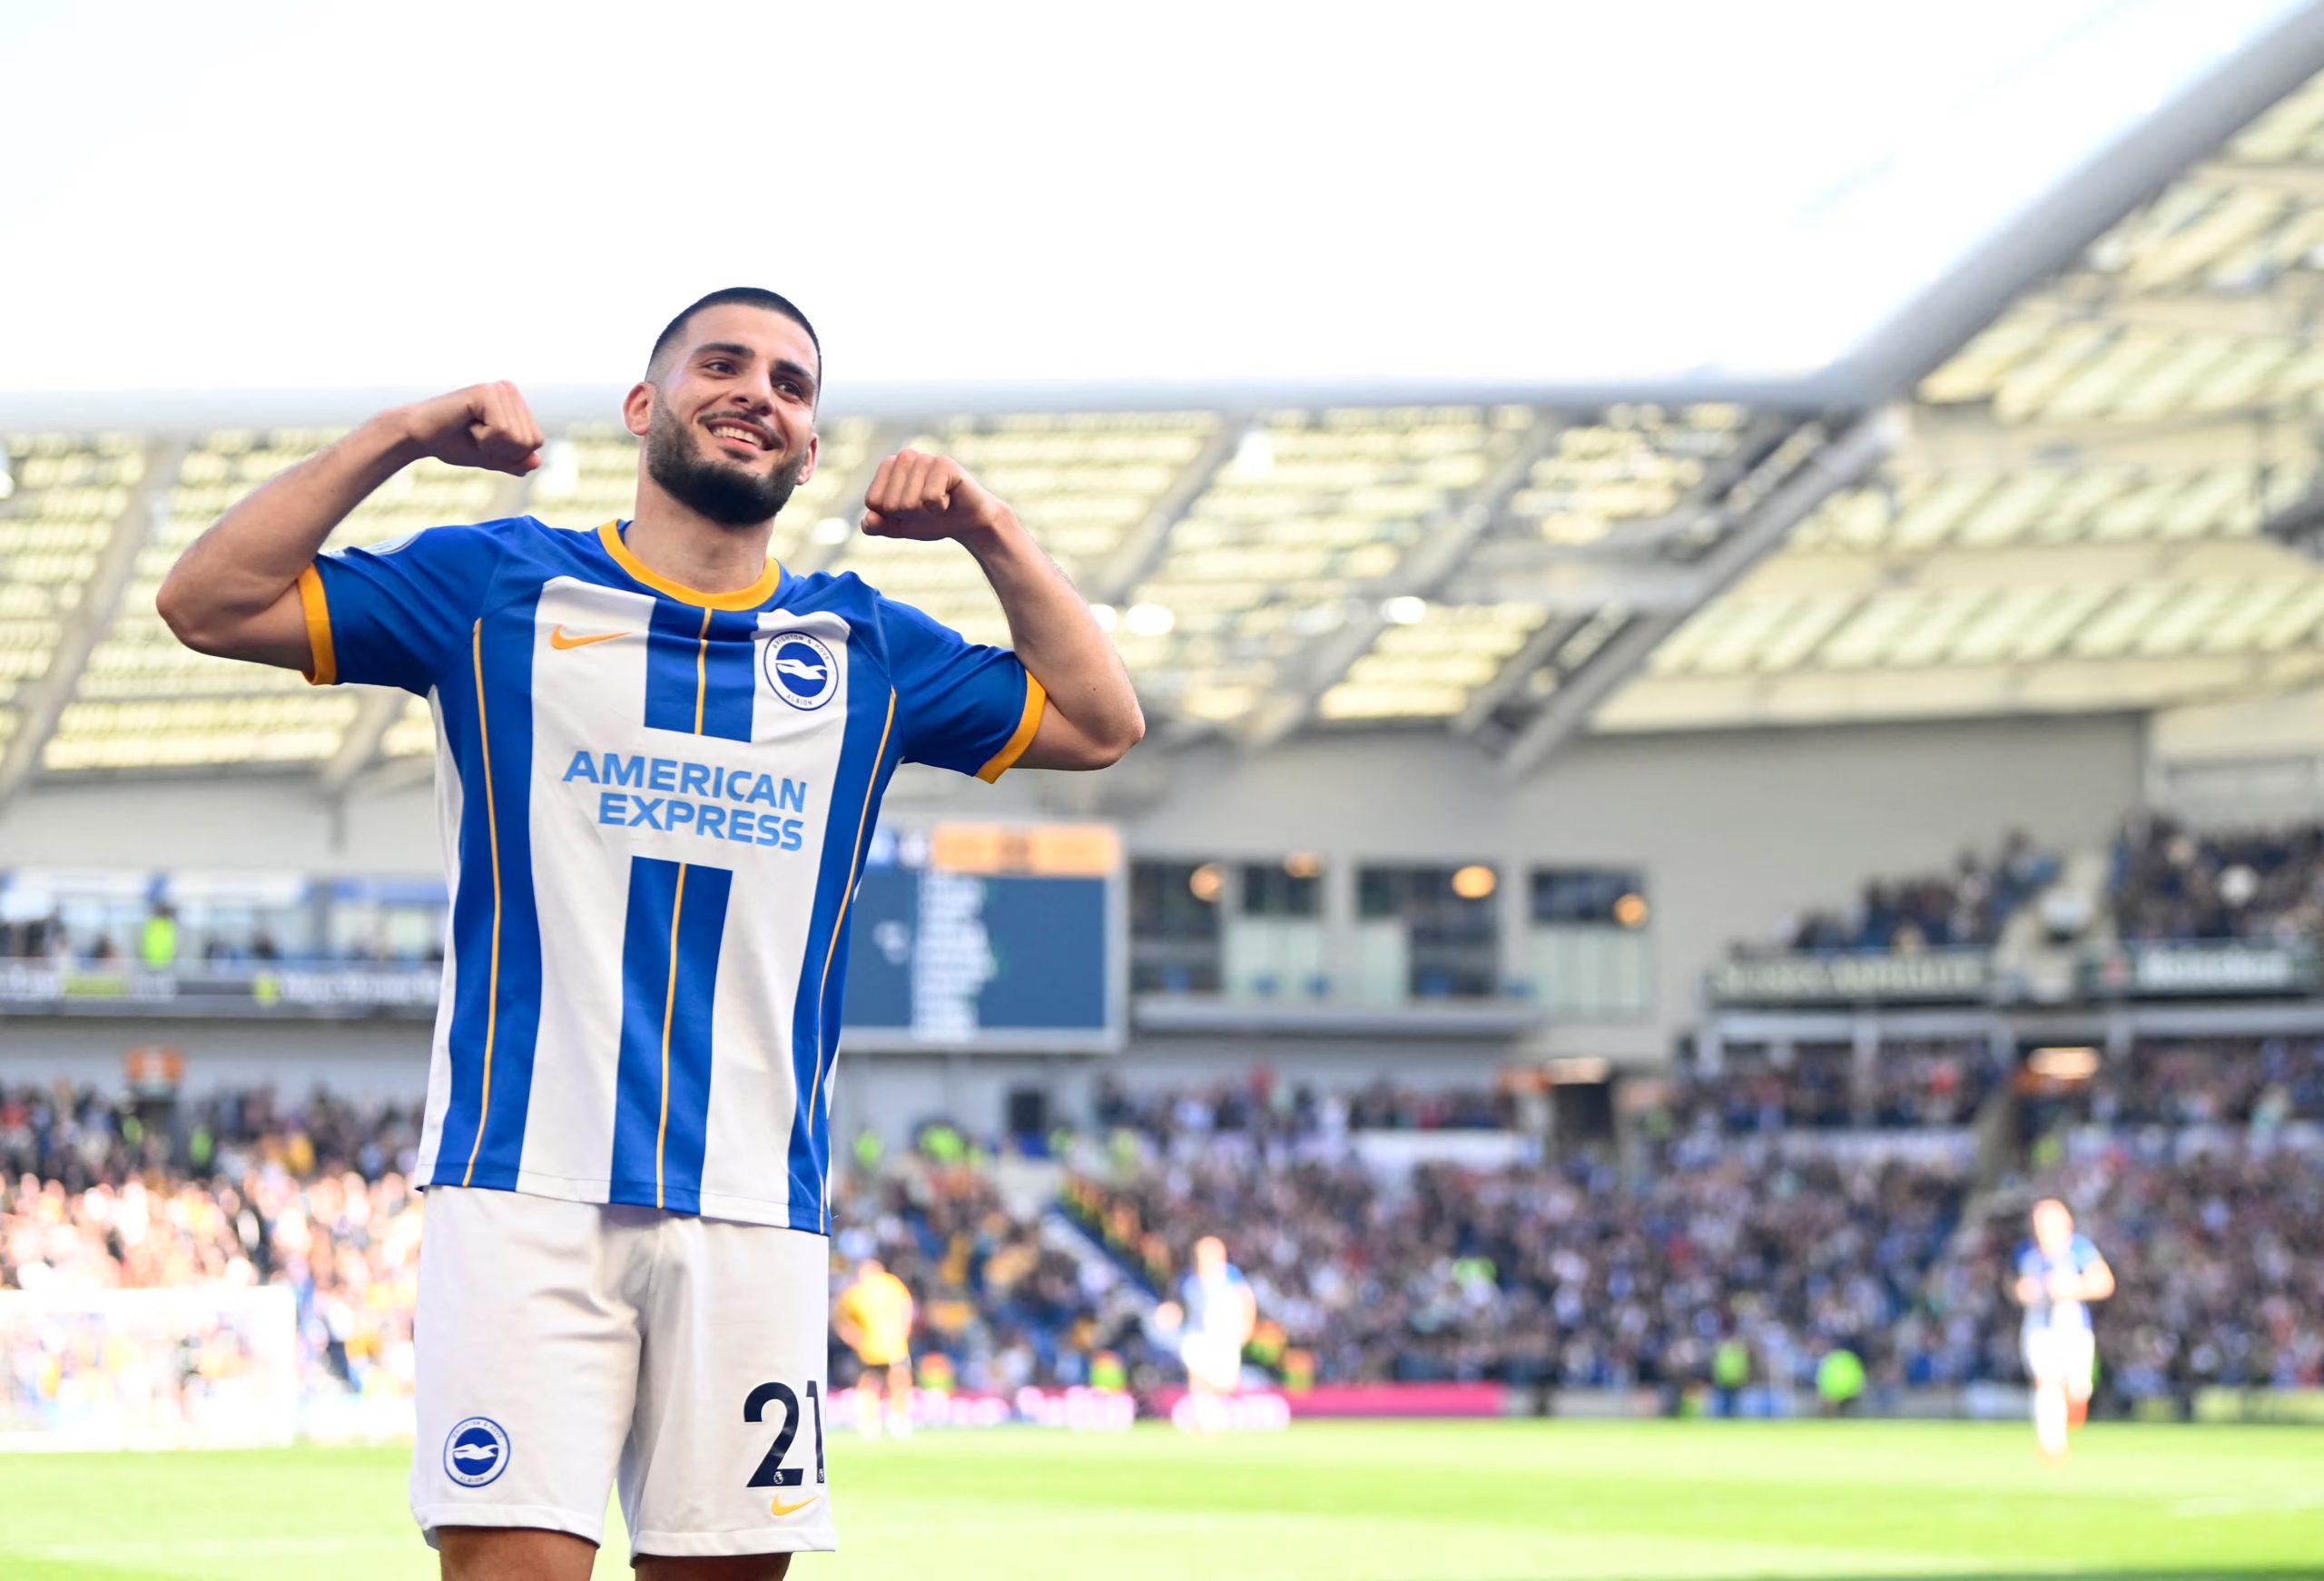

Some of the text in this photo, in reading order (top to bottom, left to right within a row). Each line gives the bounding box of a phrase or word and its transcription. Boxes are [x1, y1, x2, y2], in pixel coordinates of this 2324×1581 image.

[786, 694, 812, 705] ALBION
[563, 751, 807, 813] AMERICAN
[599, 792, 804, 851] EXPRESS
[743, 1380, 824, 1488] 21
